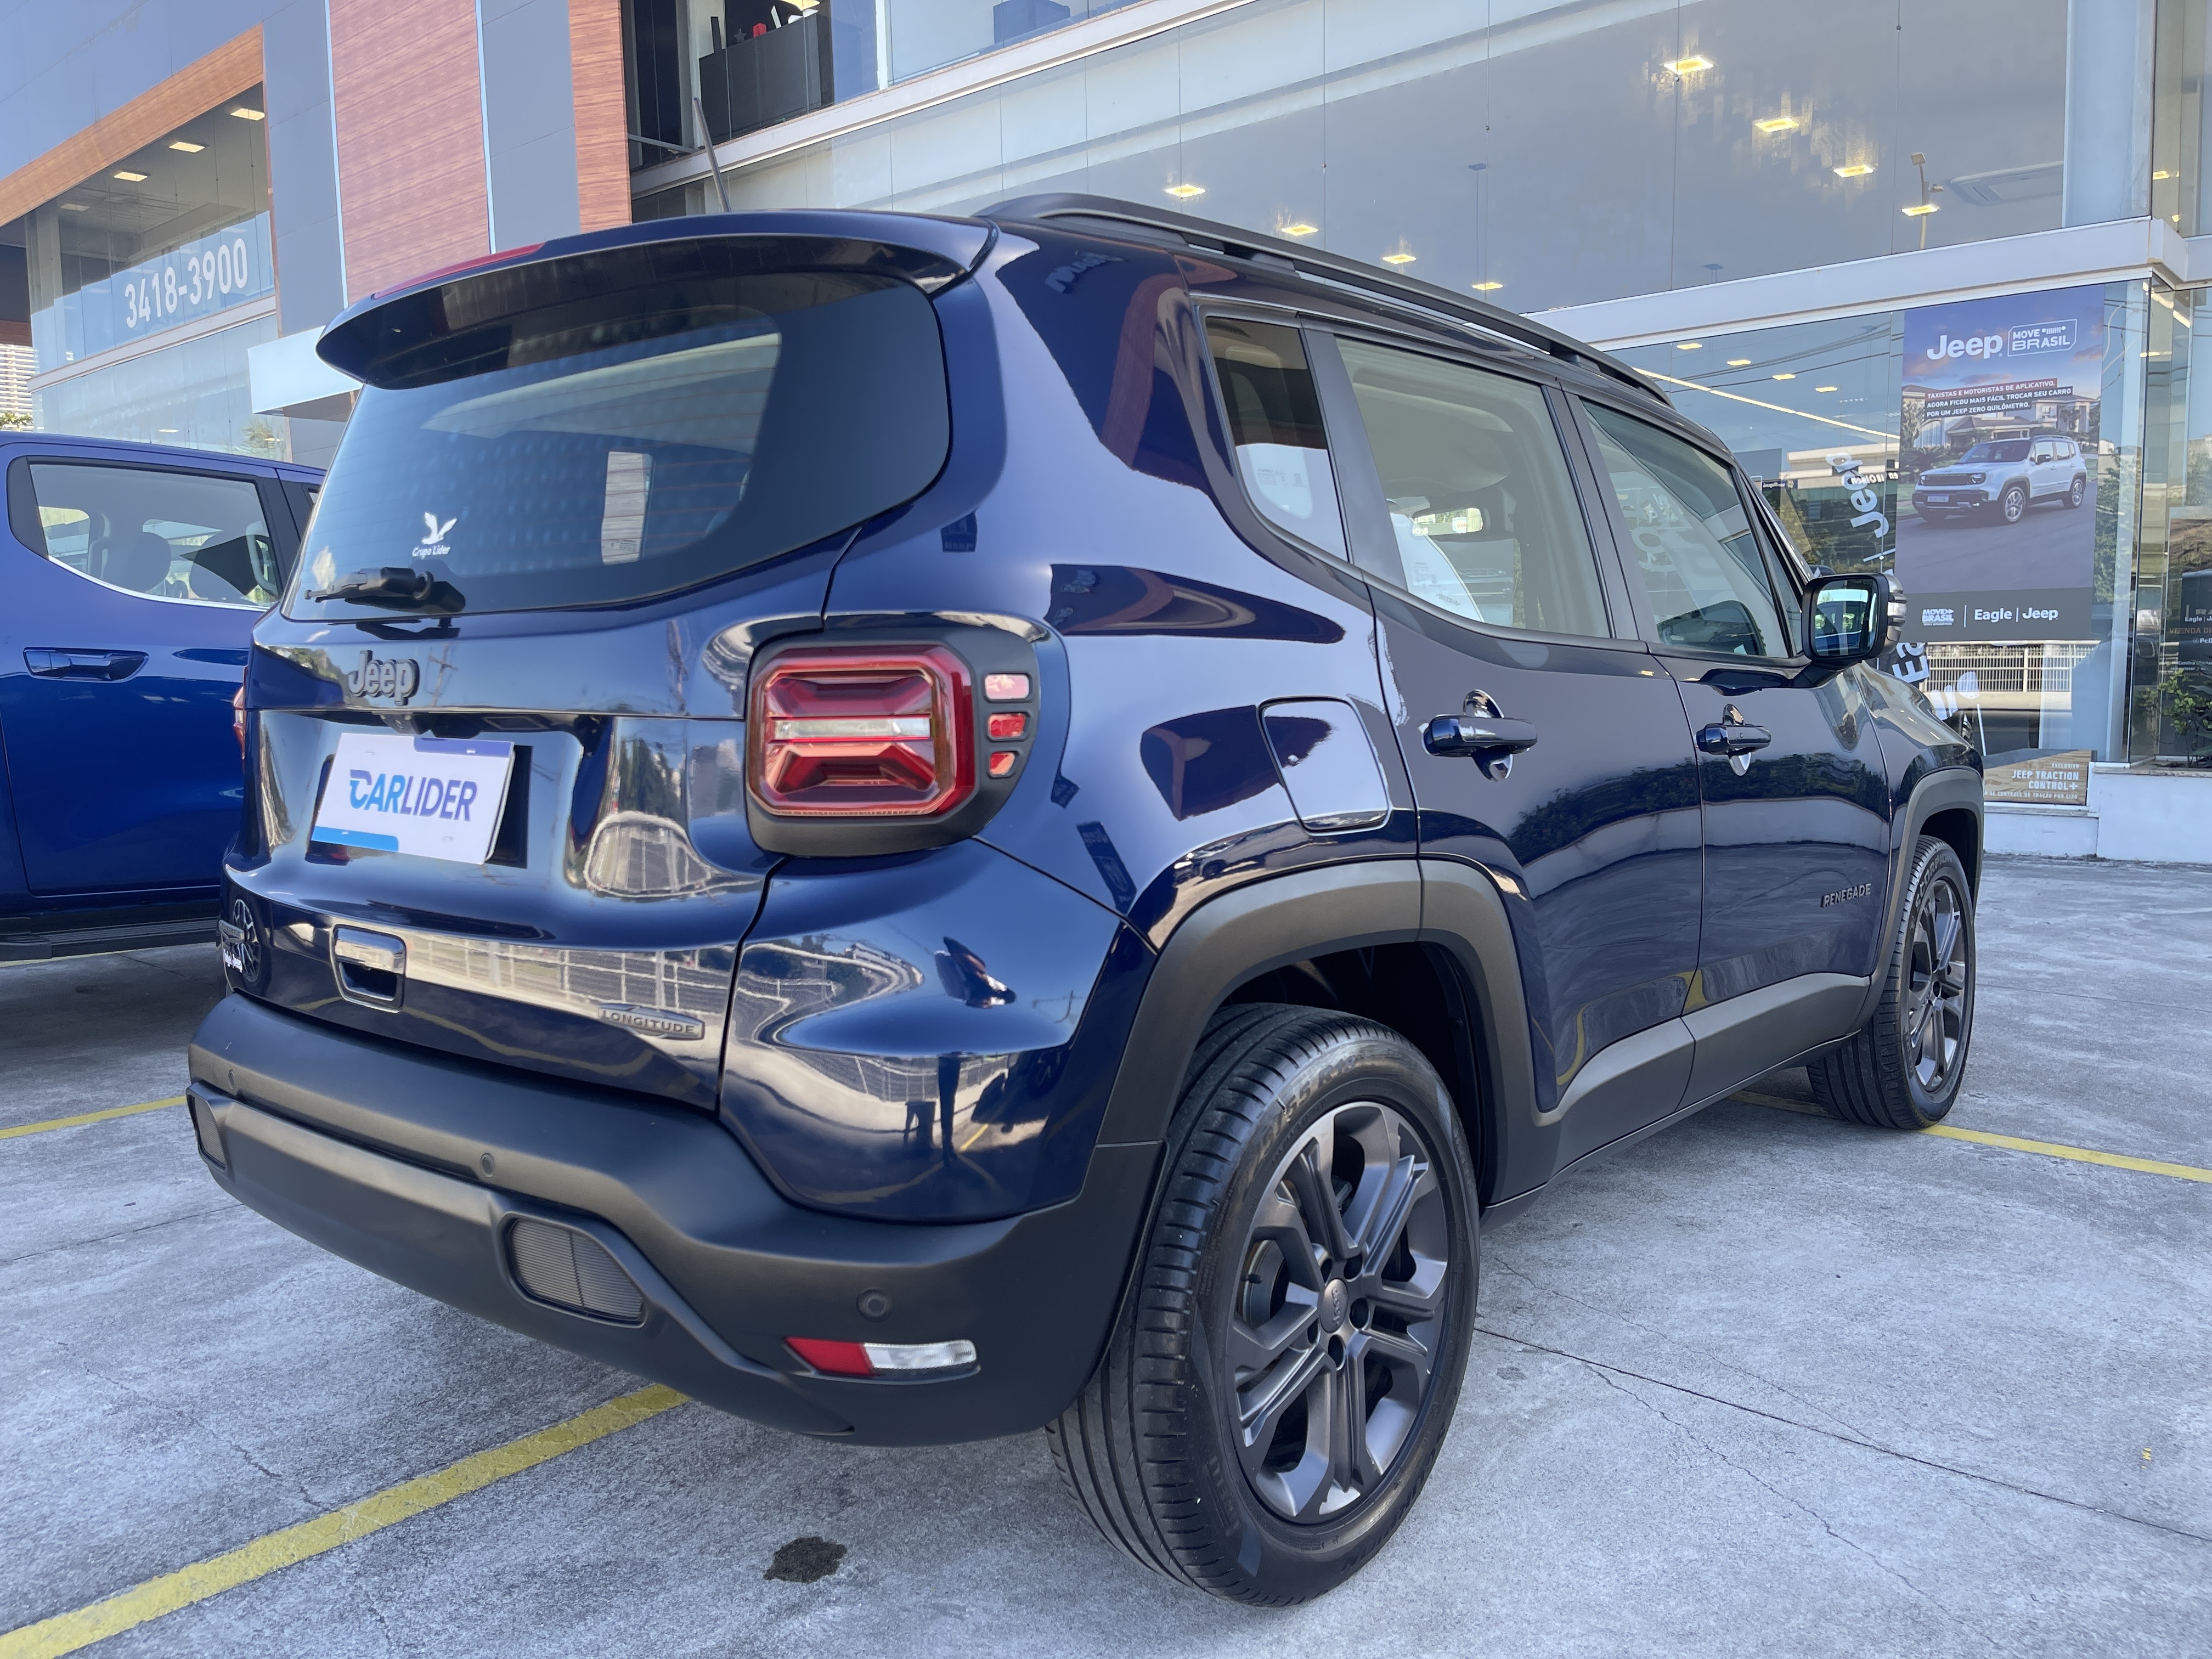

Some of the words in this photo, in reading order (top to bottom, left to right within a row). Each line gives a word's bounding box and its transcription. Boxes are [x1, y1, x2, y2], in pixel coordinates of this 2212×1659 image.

[125, 238, 249, 330] 3418-3900
[2012, 329, 2040, 340] MOVE
[1926, 334, 2003, 360] Jeep
[2012, 335, 2070, 352] BRASIL
[1927, 390, 1957, 399] TAXISTAS
[1963, 386, 2004, 396] MOTORISTAS
[1987, 394, 2005, 402] FÁCIL
[2006, 392, 2033, 400] TROCAR
[2049, 388, 2071, 396] CARRO
[1968, 405, 1985, 414] ZERO
[1825, 453, 1889, 538] Jeep
[412, 546, 432, 560] Grupo
[1974, 607, 2012, 623] Eagle
[2022, 607, 2058, 620] Jeep
[348, 650, 420, 706] Jeep
[2012, 770, 2033, 778] JEEP
[2035, 770, 2080, 781] TRACTION
[349, 769, 477, 822] CARLIDER
[1820, 883, 1871, 908] RENEGADE
[602, 1009, 696, 1035] LONGITUDE
